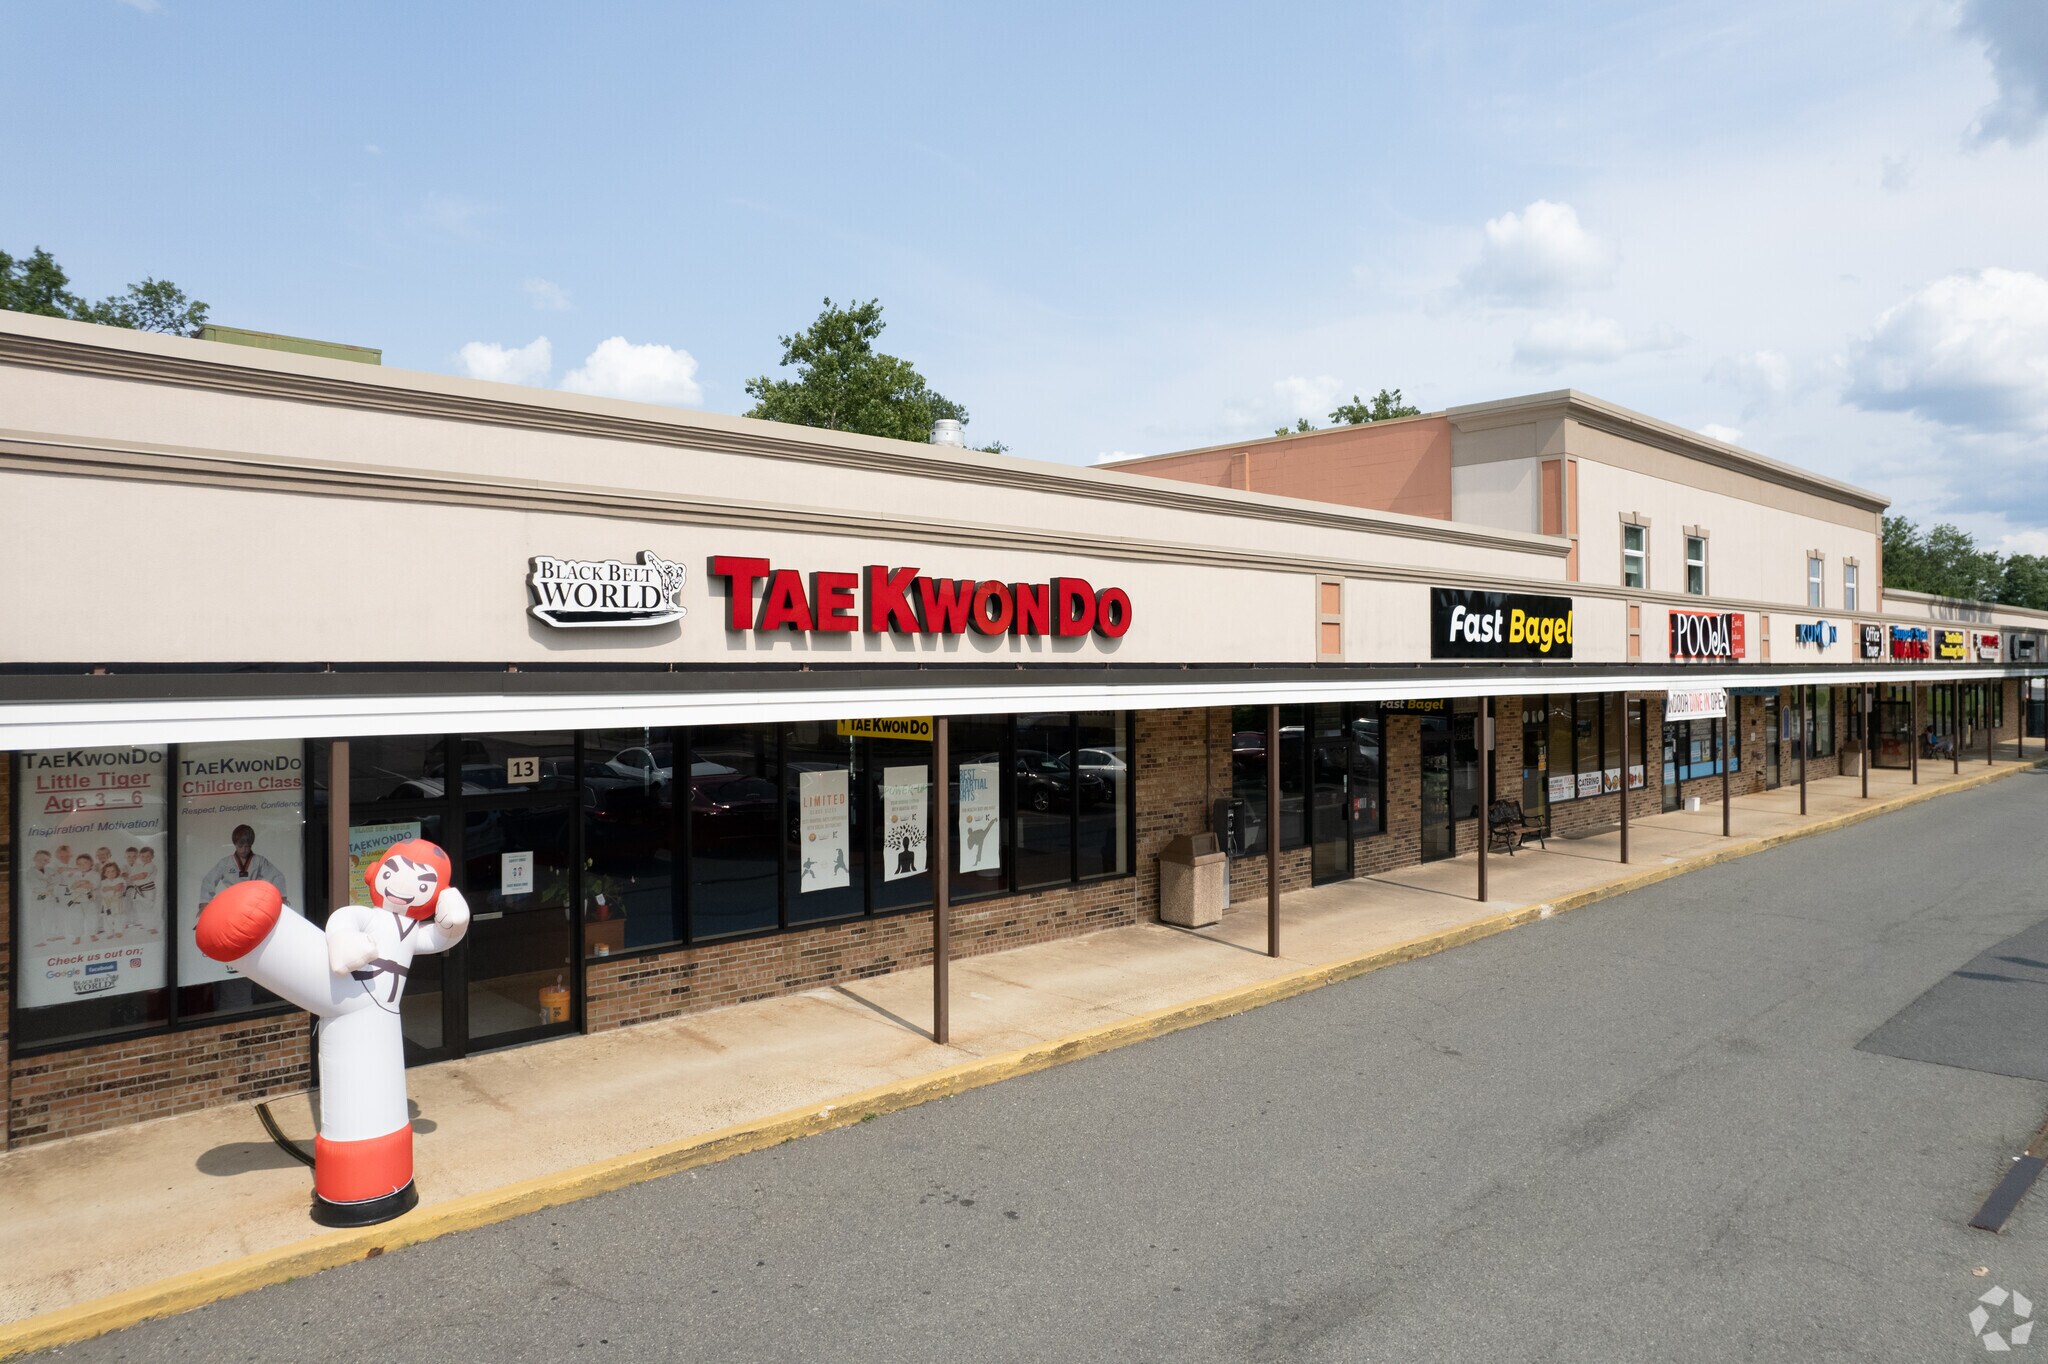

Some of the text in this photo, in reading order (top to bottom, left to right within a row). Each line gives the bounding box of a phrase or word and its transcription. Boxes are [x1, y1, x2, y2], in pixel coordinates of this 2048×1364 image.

[541, 560, 653, 583] BLACK BELT
[540, 581, 662, 609] WORLD
[708, 555, 1133, 639] TAEKWONDO
[1449, 604, 1573, 653] Fast Bagel
[1800, 620, 1837, 648] KUMON
[1865, 626, 1880, 642] Office
[1866, 642, 1880, 657] Tower
[1893, 639, 1931, 659] NAILS
[1380, 700, 1444, 712] Fast Bagel
[1668, 694, 1688, 713] NDOOR
[1689, 693, 1703, 712] DINE
[1711, 692, 1723, 711] OPE
[850, 718, 929, 735] TAEKWONDO
[22, 749, 162, 769] TAEKWONDO
[182, 756, 302, 776] TAEKWONDO
[513, 761, 534, 778] 13
[36, 771, 151, 790] Little Tiger
[182, 777, 302, 795] Children Class
[1578, 778, 1600, 788] CATERING
[45, 795, 88, 812] Age
[95, 792, 106, 807] 3
[131, 790, 142, 805] 6
[182, 807, 217, 815] Respect,
[219, 804, 258, 813] Discipline,
[803, 793, 845, 808] LIMITED
[28, 818, 160, 837] Inspiration! Motivation!
[349, 831, 413, 853] TAEKWONDO
[47, 955, 84, 967] Check
[87, 953, 100, 962] us
[104, 950, 123, 959] out
[46, 967, 81, 979] Google
[73, 981, 113, 993] WORLD
